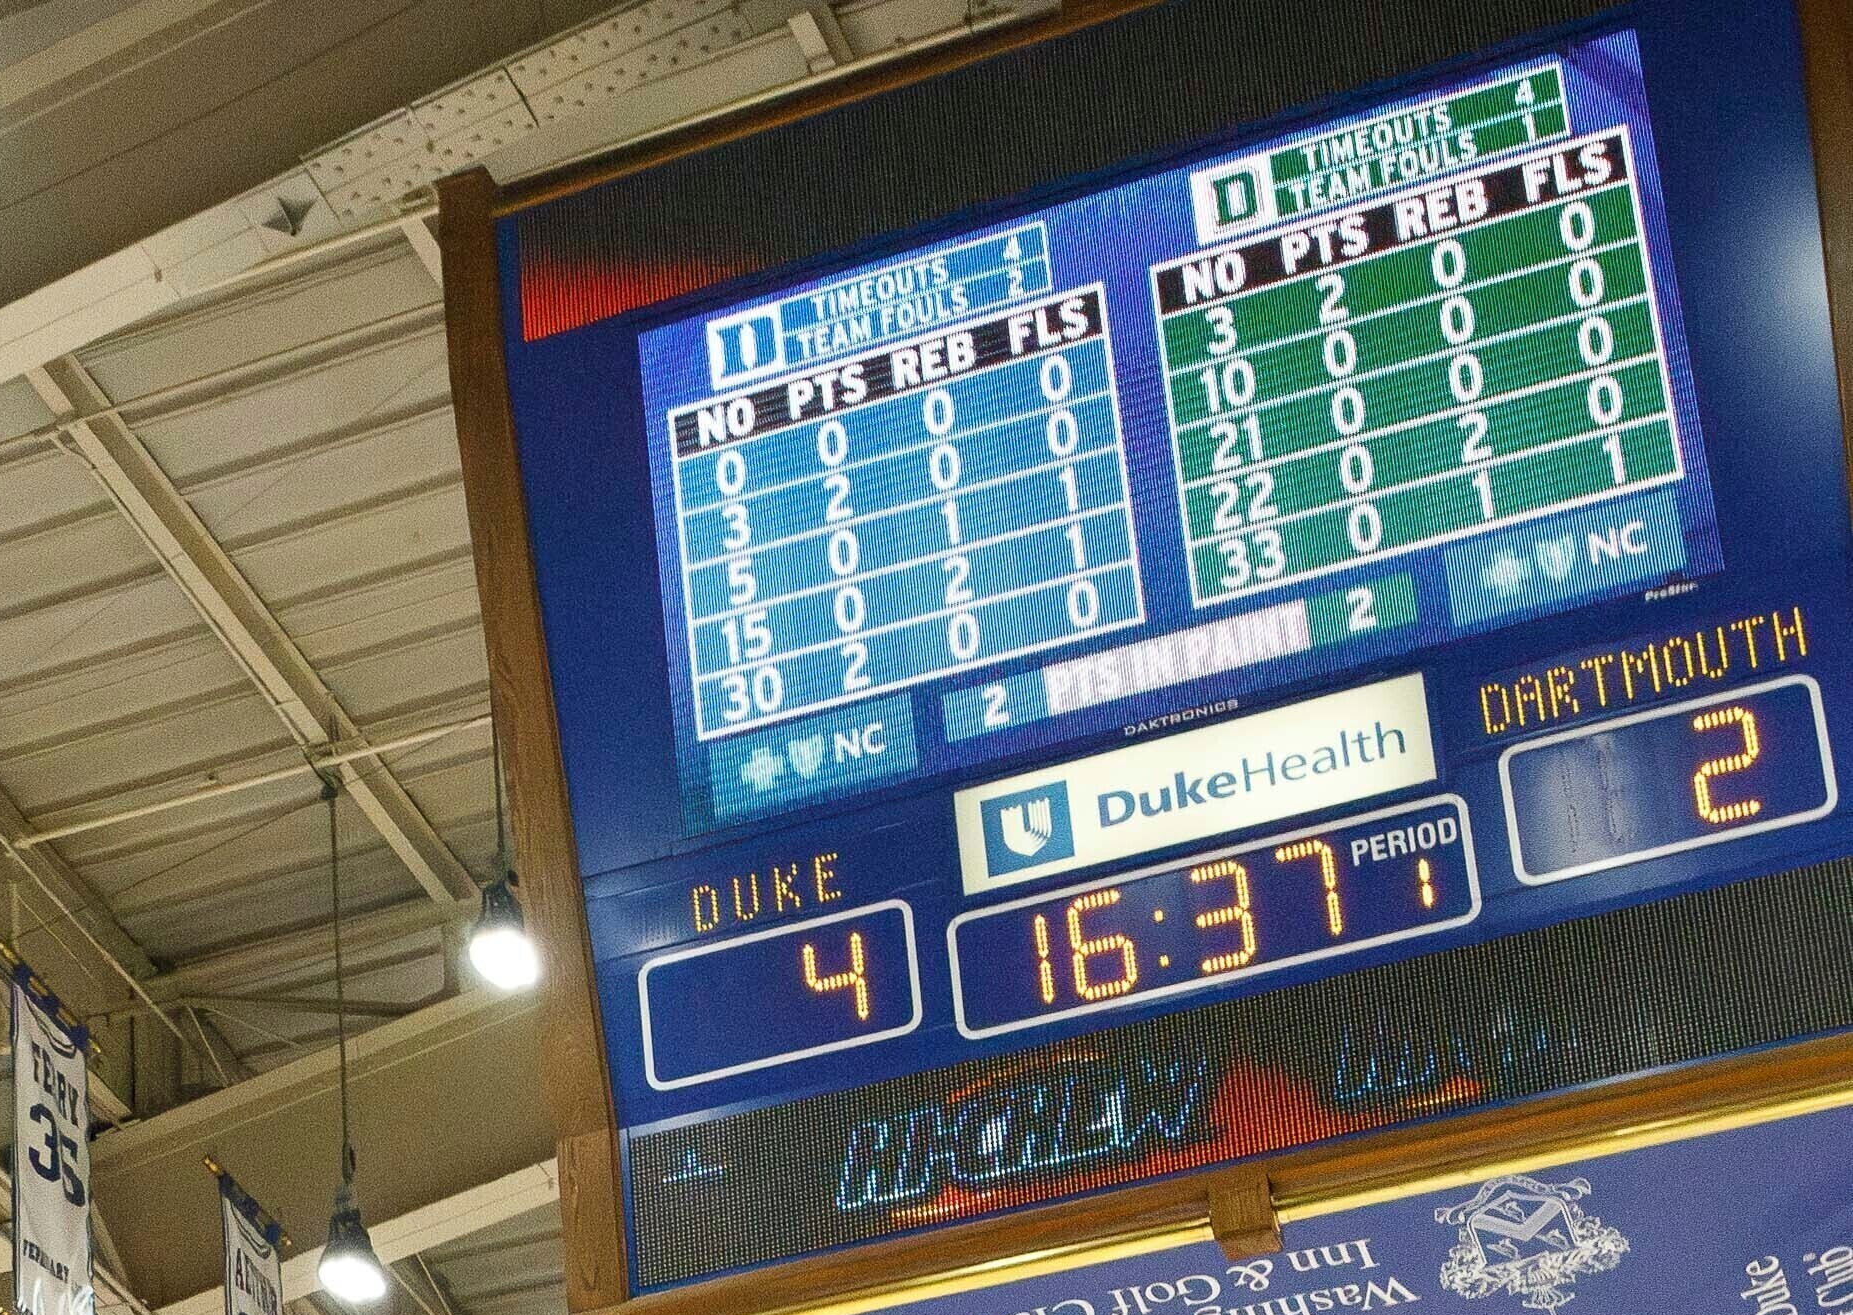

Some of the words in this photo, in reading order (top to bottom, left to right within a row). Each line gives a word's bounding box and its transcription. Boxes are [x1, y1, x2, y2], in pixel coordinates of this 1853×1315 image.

[1289, 163, 1370, 212] TEAM
[1380, 133, 1477, 187] FOULS
[1302, 102, 1450, 166] TIMEOUTS
[1183, 252, 1246, 303] NO
[1281, 216, 1368, 274] PTS
[1395, 181, 1487, 240] REB
[1523, 143, 1610, 201] FLS
[1207, 308, 1236, 354] 3
[1318, 275, 1345, 324] 2
[1431, 240, 1466, 288] 0
[1560, 201, 1593, 250] 0
[798, 317, 870, 359] TEAM
[880, 287, 968, 344] FOULS
[811, 262, 948, 321] TIMEOUTS
[1203, 360, 1254, 412] 10
[1324, 330, 1356, 379] 0
[1441, 298, 1474, 344] 0
[1568, 260, 1604, 306] 0
[694, 400, 754, 446] NO
[787, 365, 867, 420] PTS
[892, 335, 976, 389] REB
[1008, 299, 1089, 354] FLS
[717, 452, 746, 496] 0
[819, 422, 848, 466] 0
[924, 391, 953, 435] 0
[1041, 356, 1071, 401] 0
[1213, 417, 1261, 471] 21
[1333, 388, 1365, 435] 0
[1449, 352, 1482, 400] 0
[1578, 318, 1611, 365] 0
[723, 505, 752, 550] 3
[825, 475, 852, 521] 2
[930, 446, 960, 489] 0
[1047, 411, 1078, 456] 0
[1210, 473, 1276, 531] 22
[1340, 444, 1372, 491] 0
[1459, 412, 1493, 462] 2
[1589, 376, 1623, 424] 0
[1220, 532, 1285, 587] 33
[1348, 505, 1380, 552] 0
[1475, 471, 1494, 519] 1
[1604, 436, 1624, 483] 1
[723, 614, 771, 666] 15
[834, 587, 864, 633] 0
[945, 557, 971, 604] 2
[1066, 527, 1085, 570] 1
[729, 560, 756, 606] 5
[829, 531, 858, 575] 0
[941, 504, 960, 544] 1
[1059, 472, 1077, 510] 1
[1589, 523, 1648, 565] NC
[723, 668, 782, 722] 30
[842, 643, 869, 690] 2
[949, 614, 979, 658] 0
[1068, 583, 1098, 626] 0
[983, 686, 1010, 729] 2
[1348, 590, 1377, 633] 2
[1480, 609, 1809, 735] DARTMOUTH
[834, 725, 886, 763] NC
[1095, 720, 1407, 830] DukeHealth
[1123, 700, 1239, 737] DAKTRONICS
[1693, 706, 1762, 825] 2
[694, 852, 840, 933] DUKE
[1350, 817, 1459, 868] PERIOD
[1415, 858, 1434, 908] 1
[802, 931, 869, 1021] 4
[1034, 838, 1344, 1005] 16:37
[28, 1103, 85, 1207] 35
[1226, 1259, 1274, 1291] &
[1286, 1238, 1380, 1271] Inn
